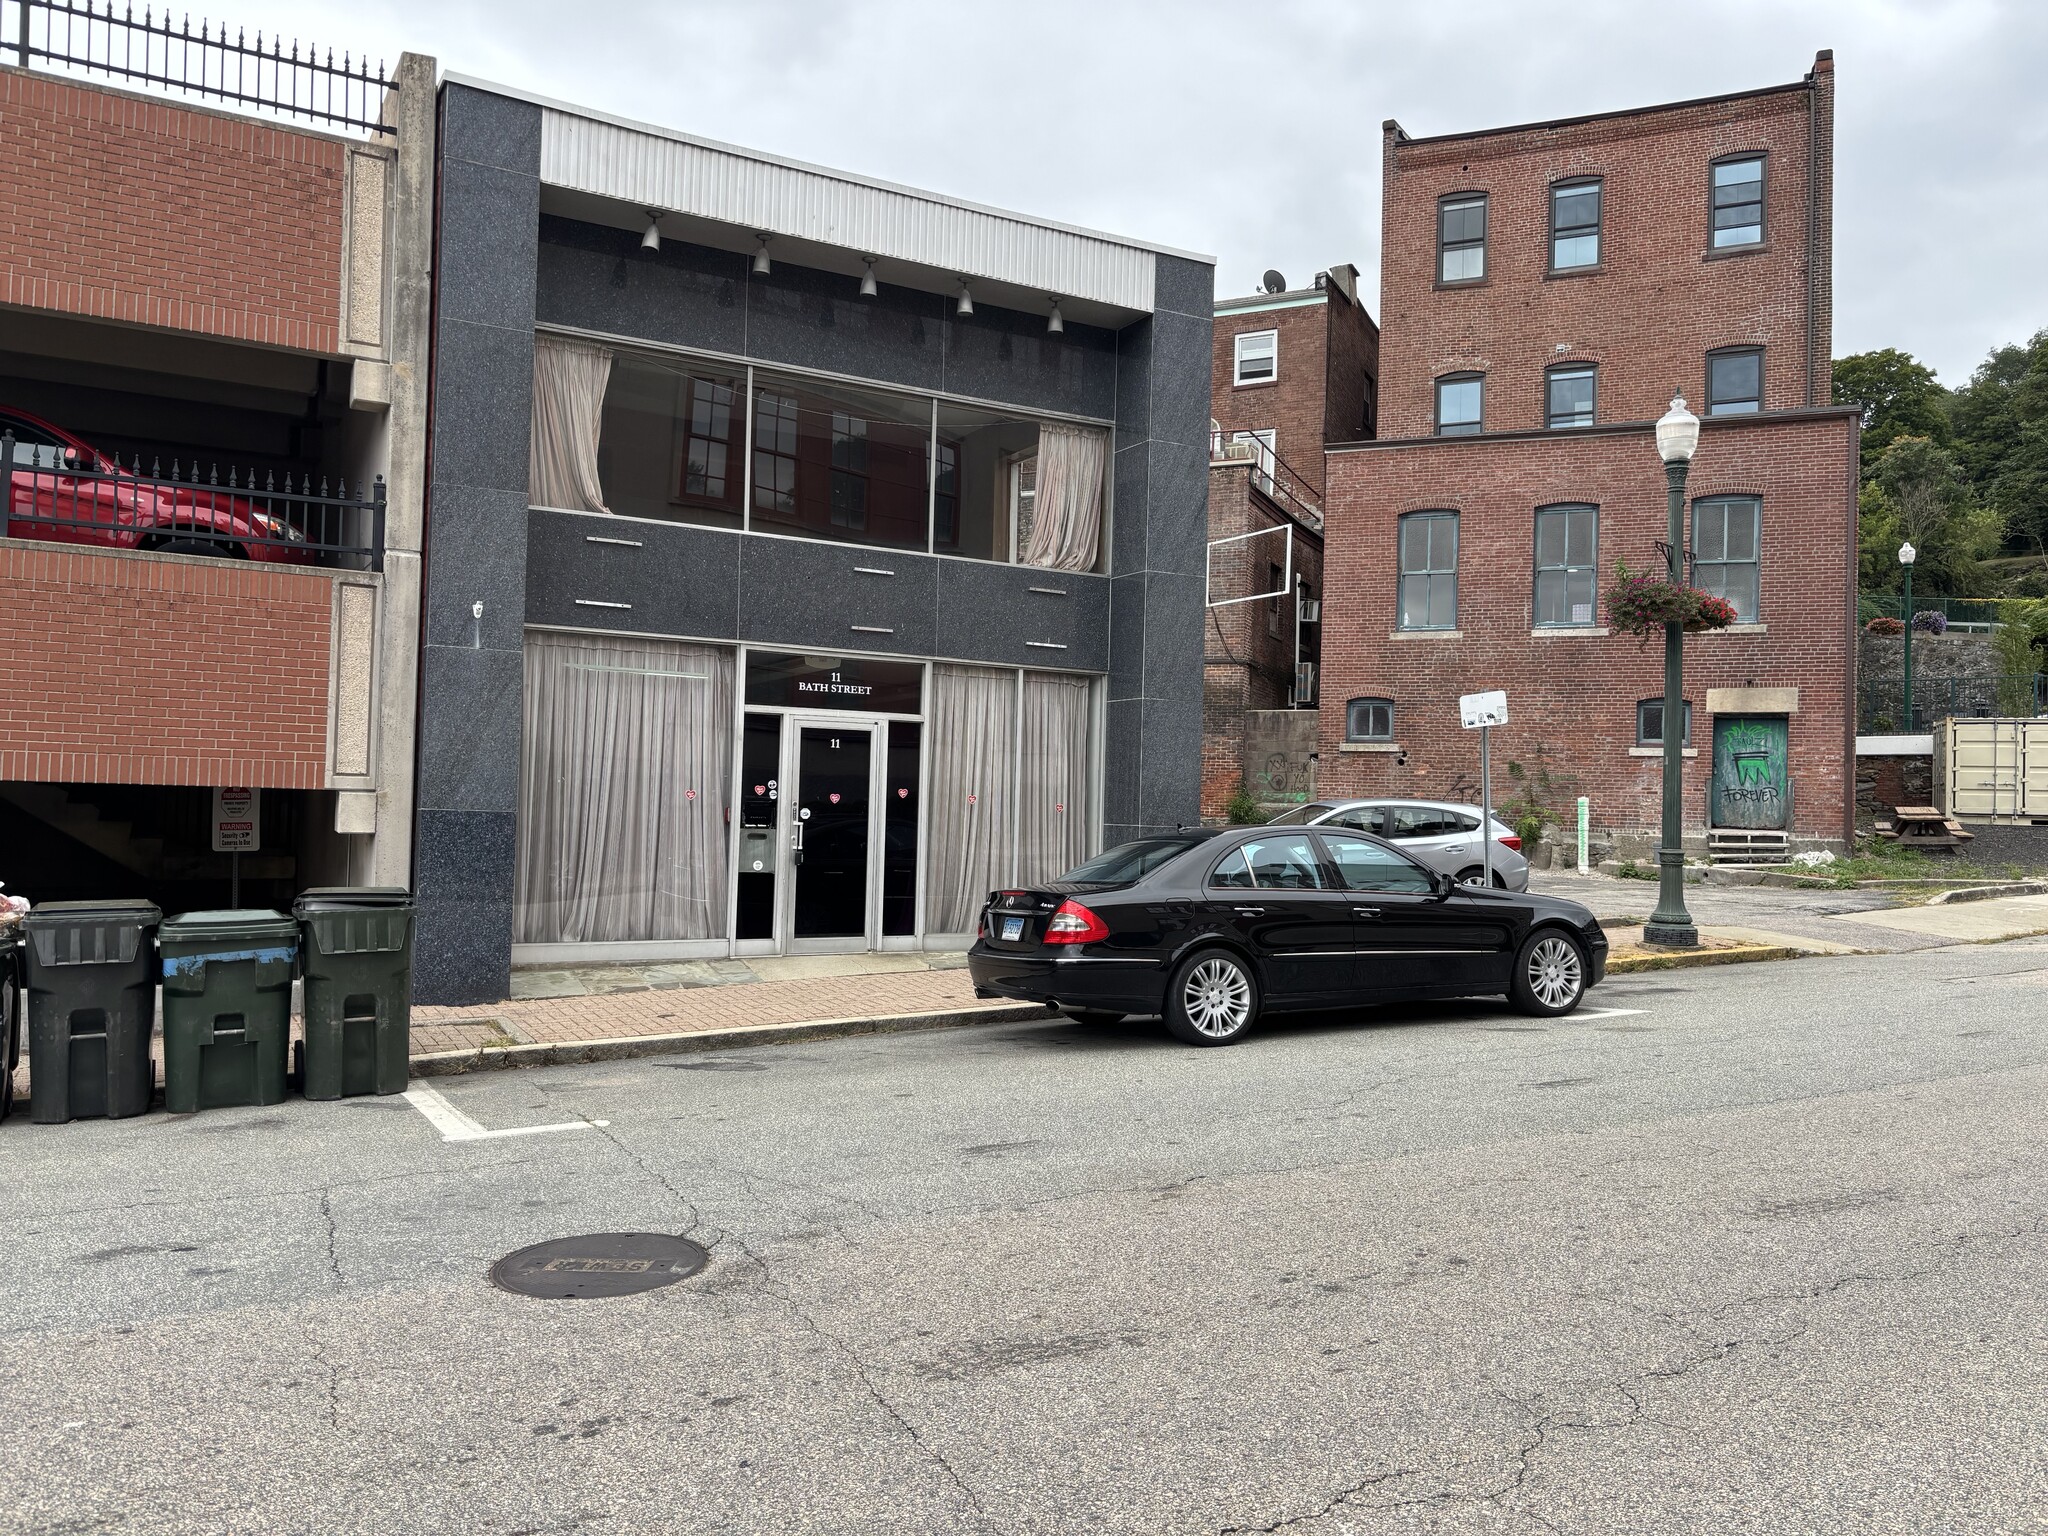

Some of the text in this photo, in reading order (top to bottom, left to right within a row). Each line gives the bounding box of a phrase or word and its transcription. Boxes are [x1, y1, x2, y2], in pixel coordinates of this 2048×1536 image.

[831, 672, 841, 682] 11
[799, 682, 872, 695] BATH STREET
[830, 738, 840, 749] 11
[1721, 785, 1781, 803] FOREVER
